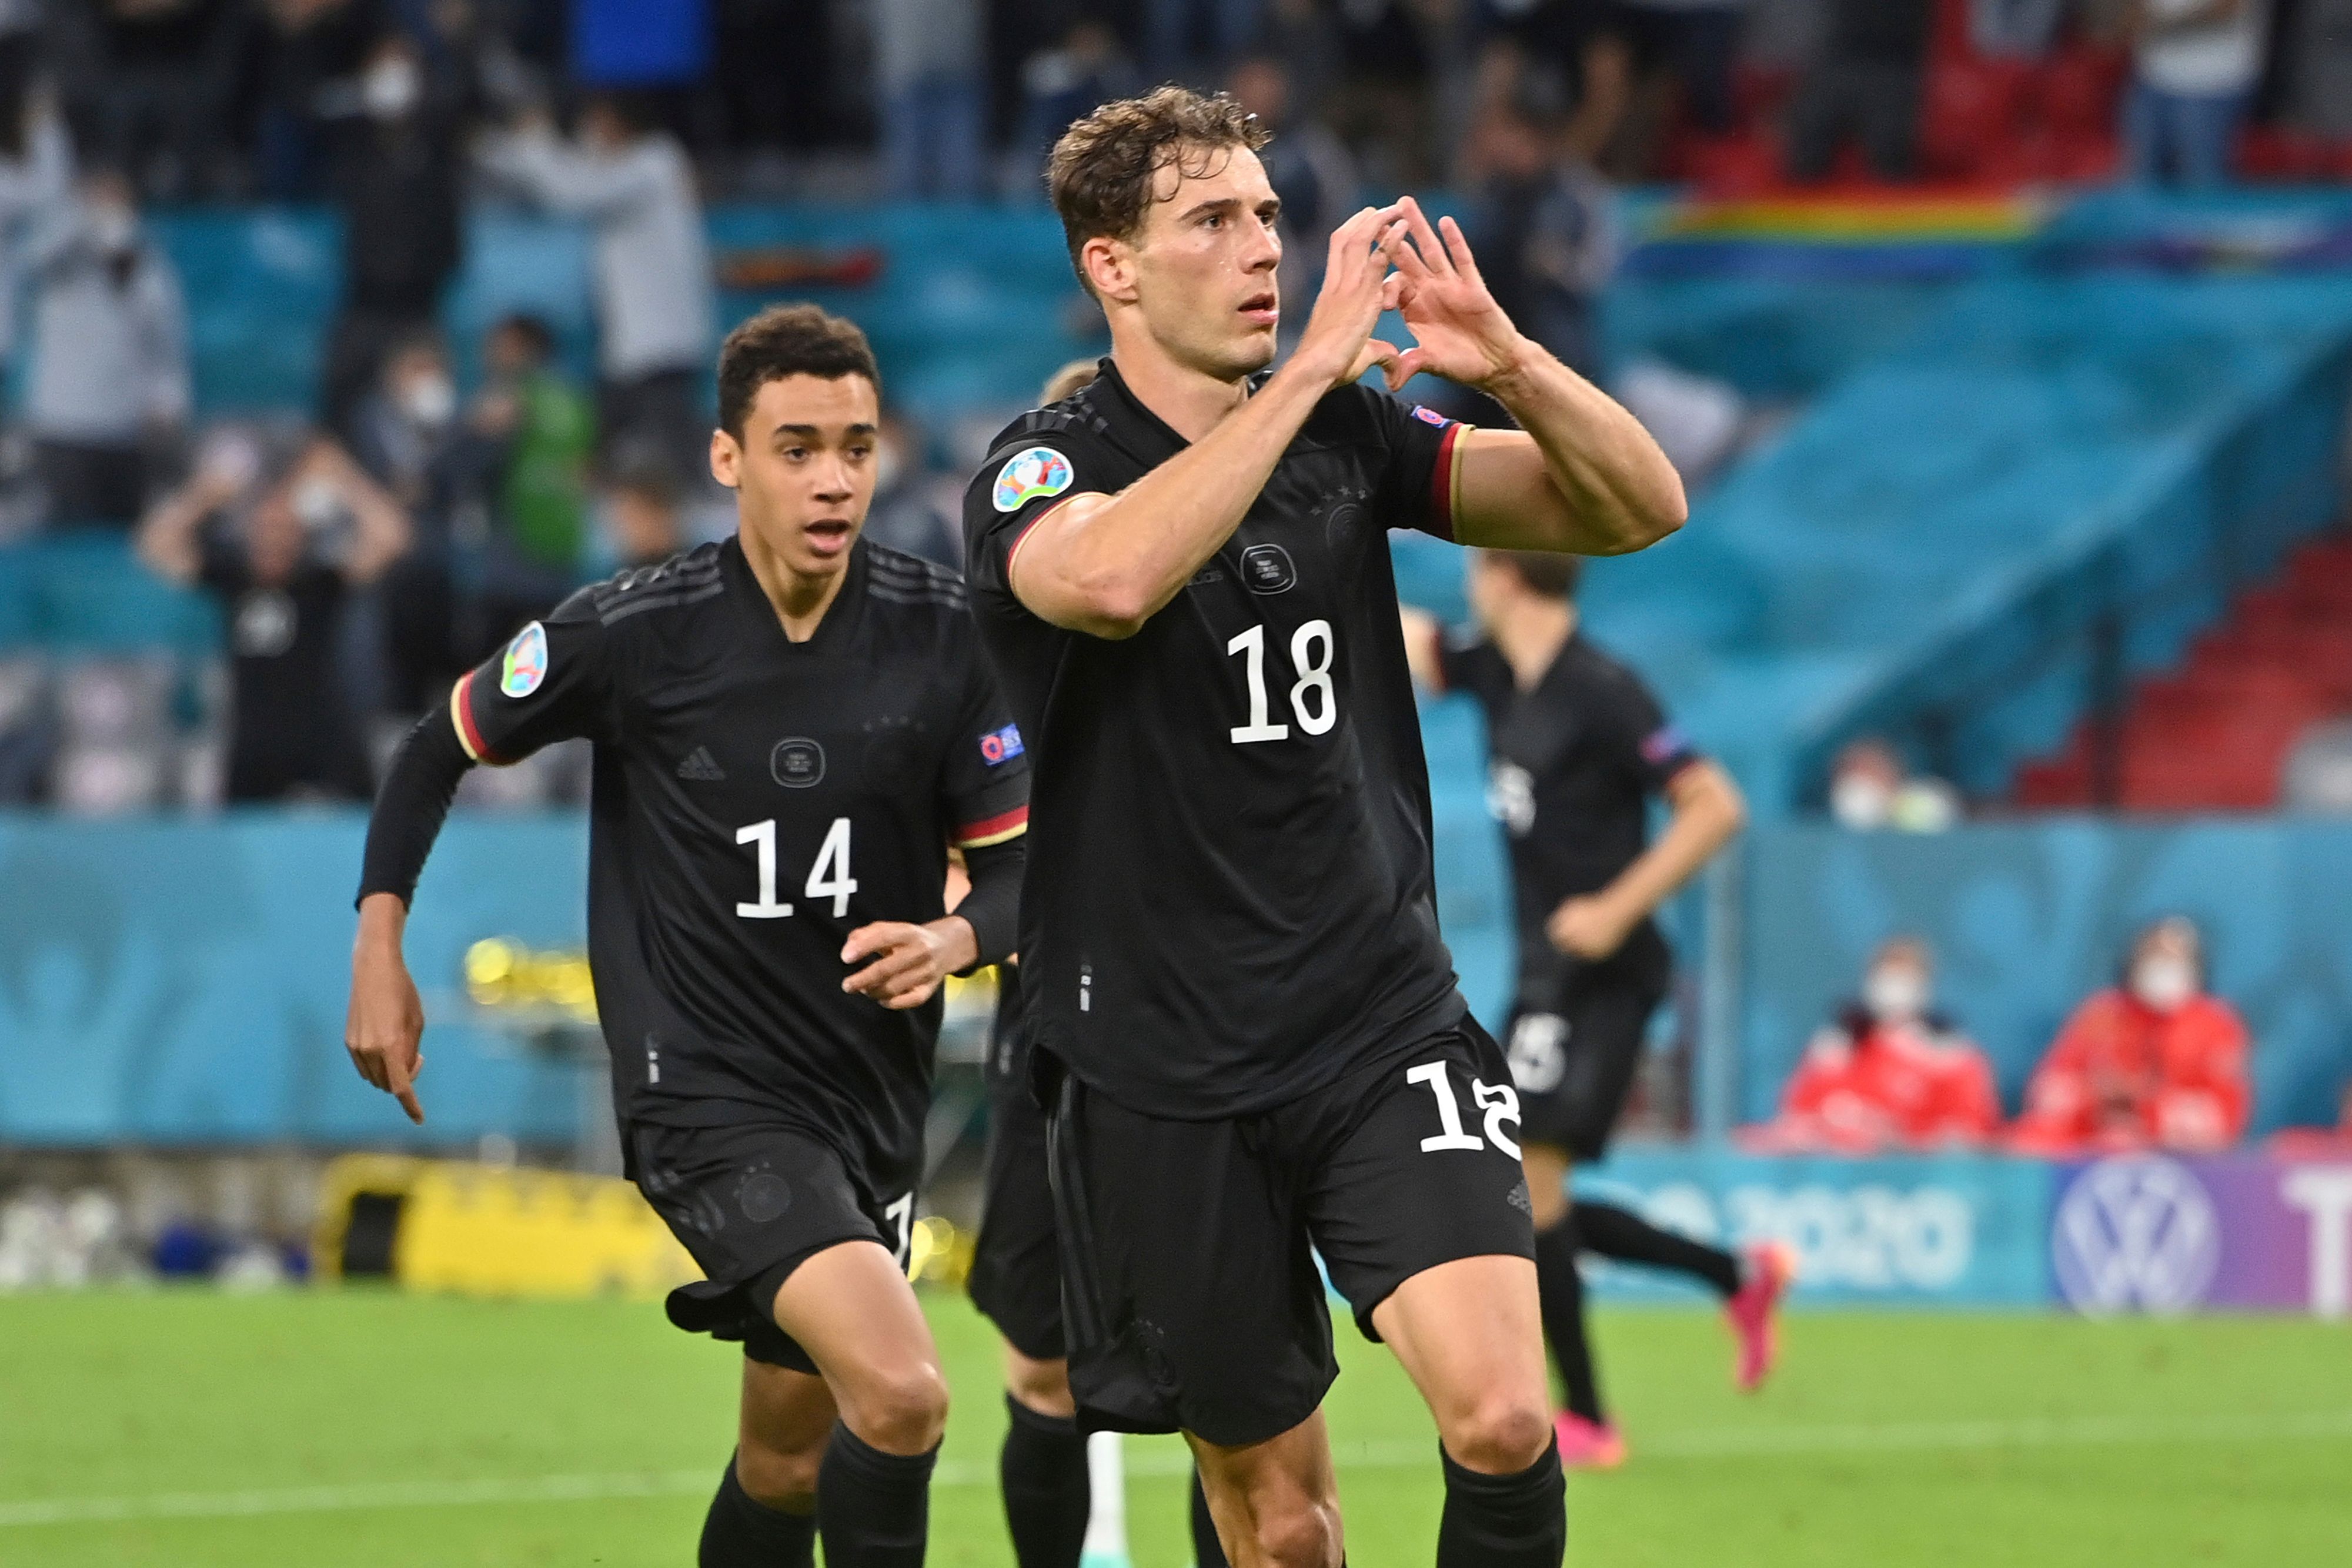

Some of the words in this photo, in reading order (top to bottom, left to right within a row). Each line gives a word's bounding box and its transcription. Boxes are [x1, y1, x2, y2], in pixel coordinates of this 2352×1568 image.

[1227, 618, 1337, 744] 18
[736, 817, 857, 918] 14
[1406, 1059, 1522, 1161] 18
